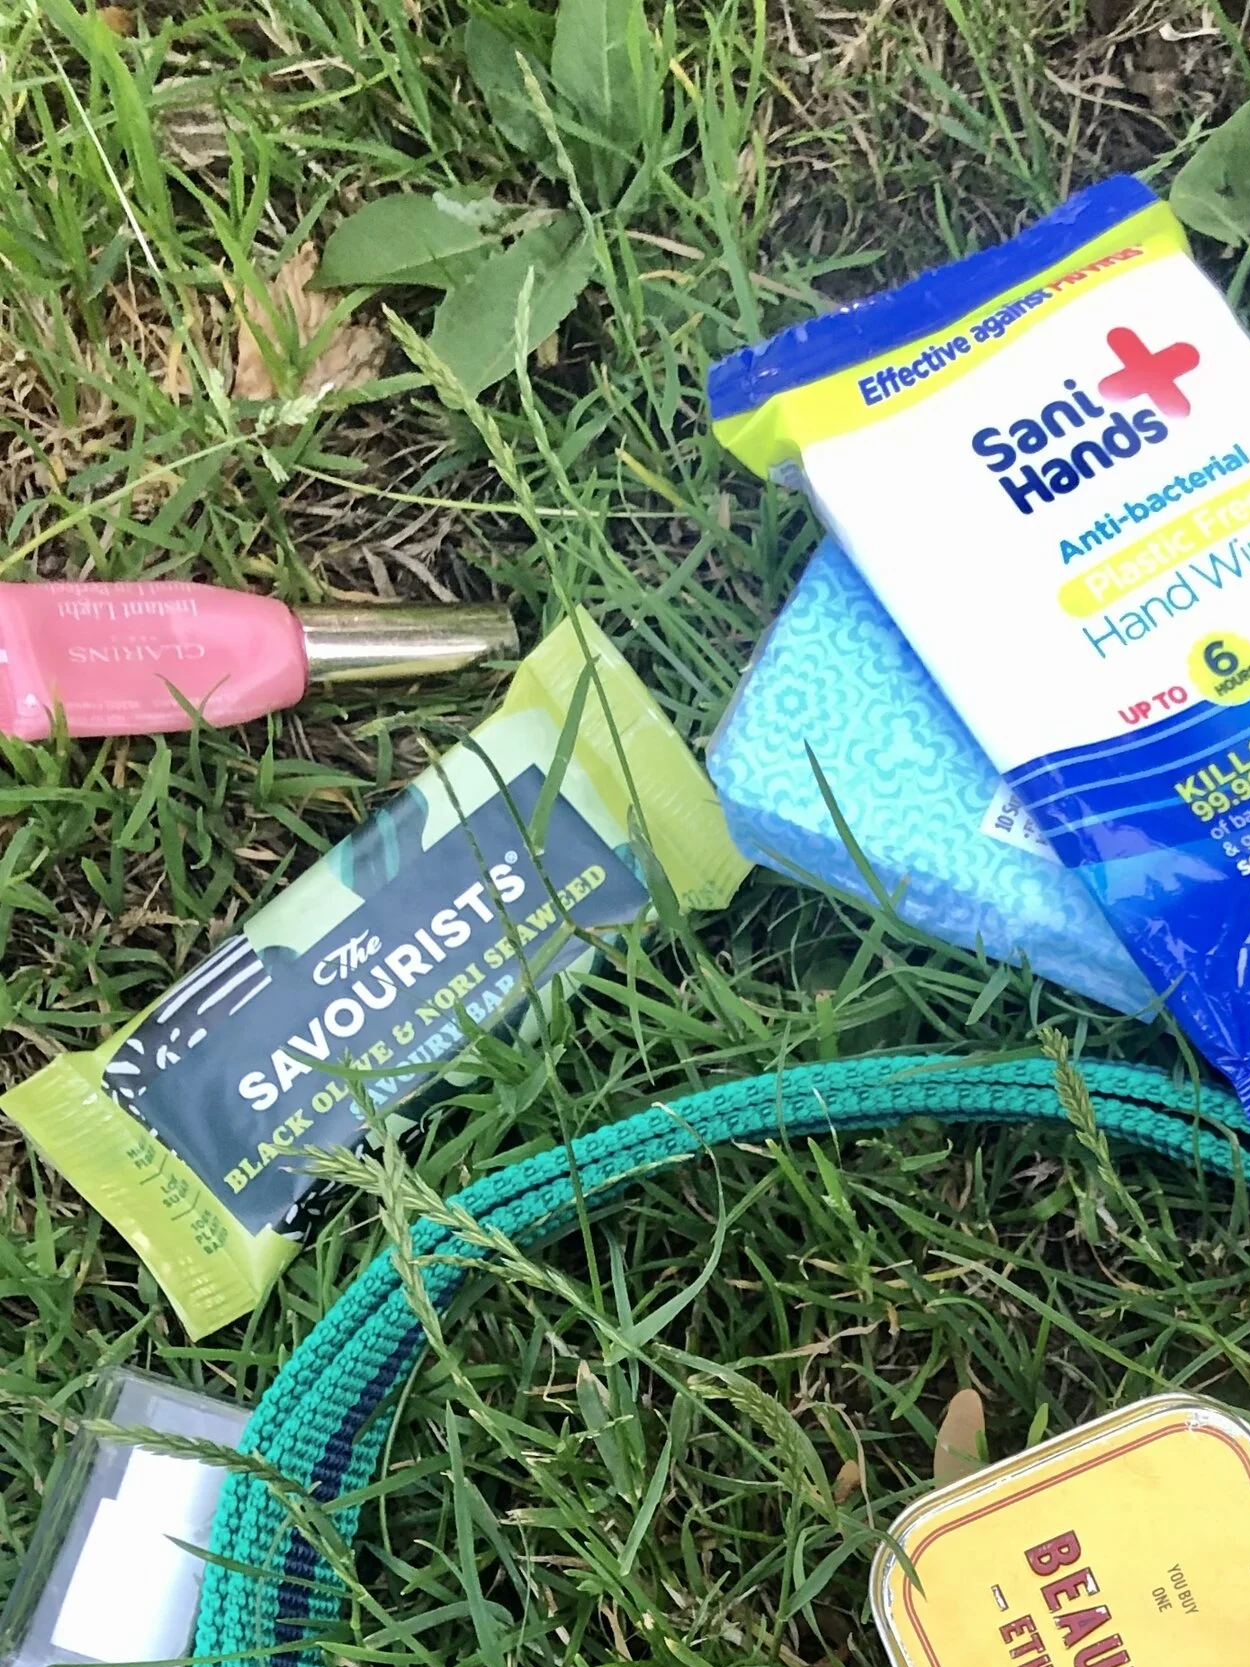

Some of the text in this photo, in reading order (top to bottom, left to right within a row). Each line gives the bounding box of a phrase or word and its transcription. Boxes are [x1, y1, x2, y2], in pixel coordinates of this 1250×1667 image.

[857, 336, 972, 406] Effective
[969, 288, 1053, 343] against
[971, 378, 1105, 473] Sani
[998, 393, 1169, 515] Hands
[1059, 443, 1250, 565] Anti-bacterial
[1084, 529, 1195, 601] Plastic
[58, 598, 197, 620] Instant Light
[1081, 571, 1200, 659] Hand
[67, 643, 205, 663] CLARINS
[1117, 700, 1152, 725] UP
[1155, 685, 1188, 710] TO
[1203, 640, 1239, 677] 6
[994, 815, 1015, 833] 10
[1210, 819, 1231, 840] of
[1222, 841, 1240, 857] &
[312, 929, 382, 986] The
[463, 970, 515, 1025] BAR
[223, 1108, 314, 1194] BLACK
[311, 1040, 394, 1113] OLVE
[392, 1020, 415, 1045] &
[414, 963, 486, 1026] NORI
[1151, 1587, 1173, 1613] ONE
[1167, 1563, 1199, 1615] YOU BUY
